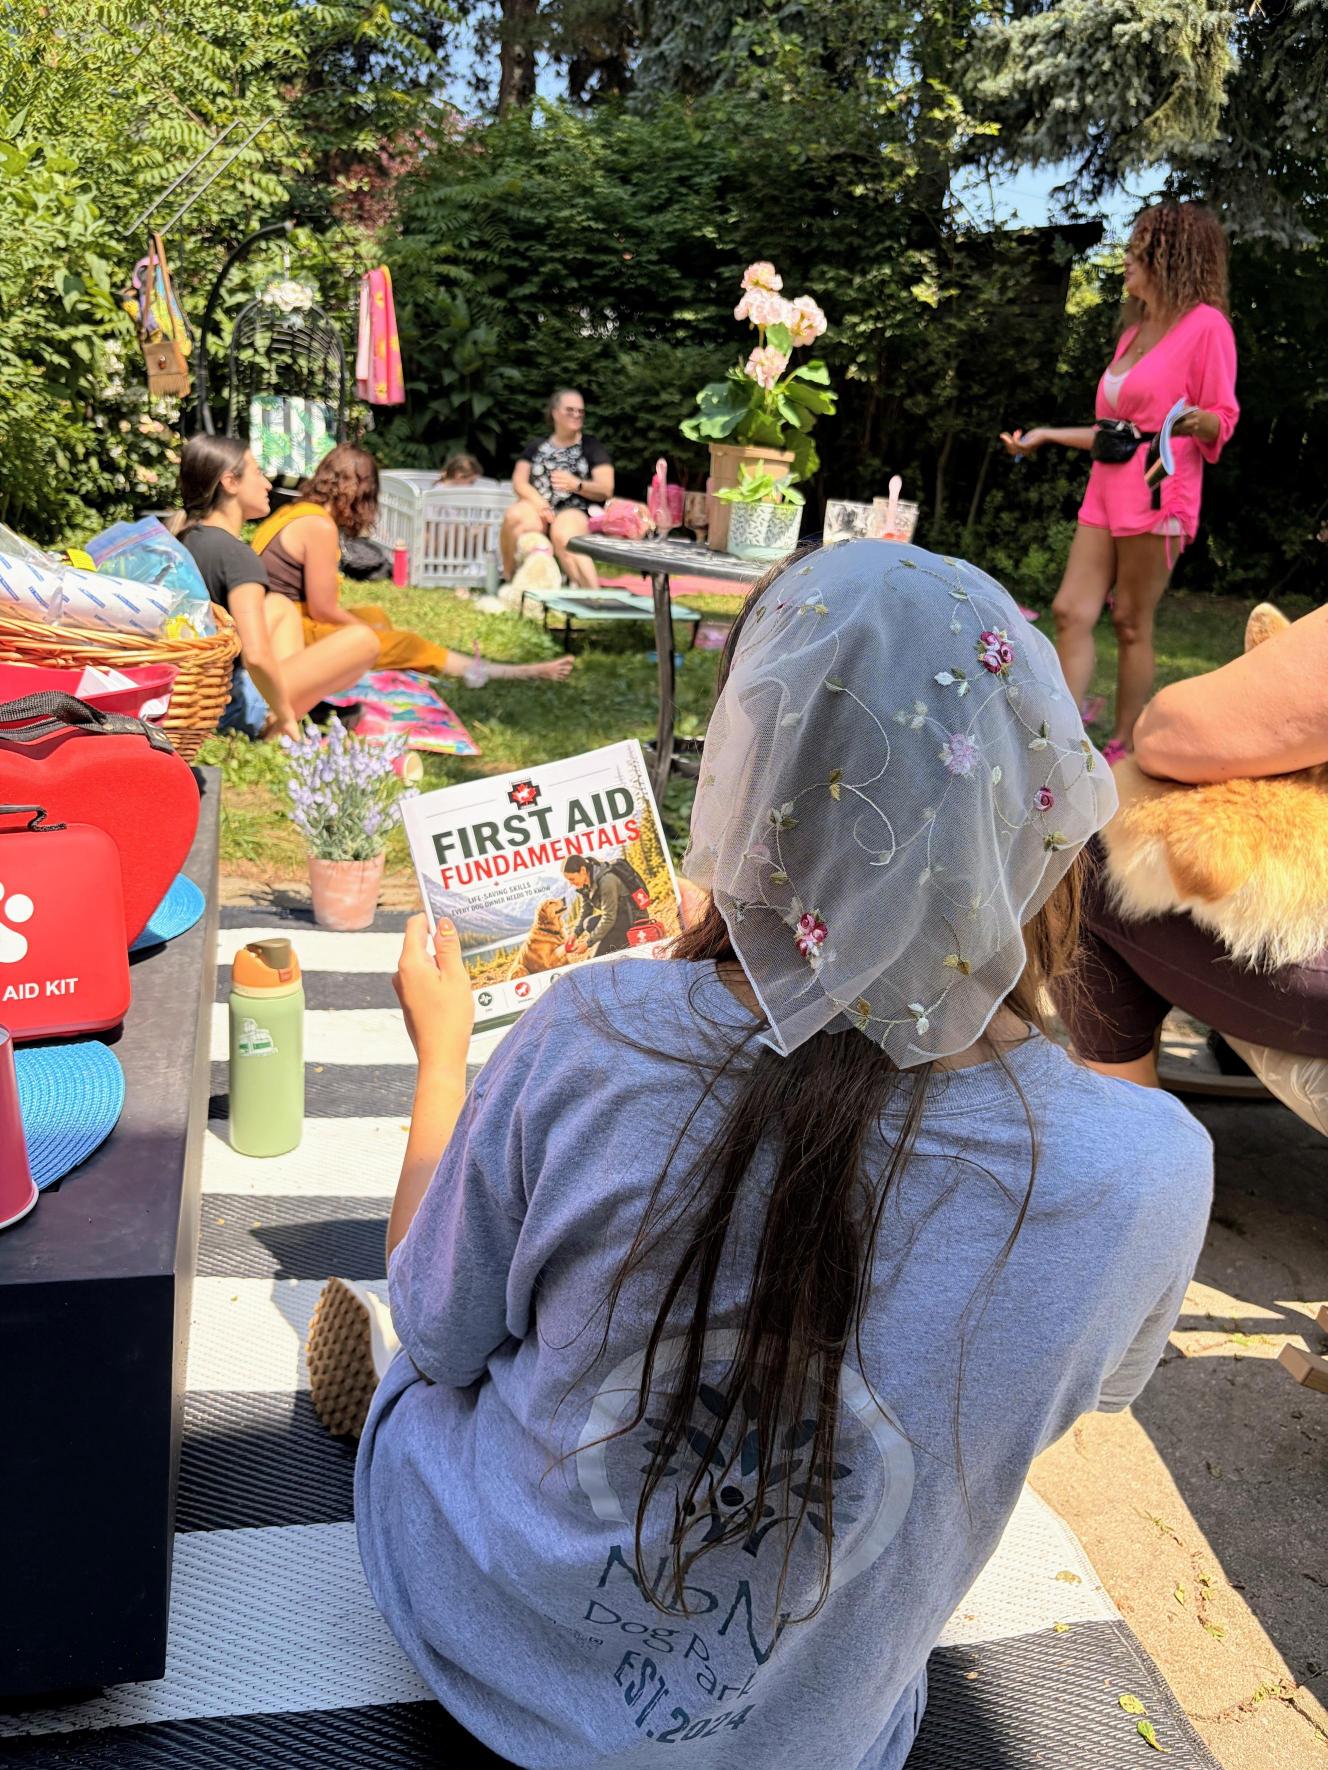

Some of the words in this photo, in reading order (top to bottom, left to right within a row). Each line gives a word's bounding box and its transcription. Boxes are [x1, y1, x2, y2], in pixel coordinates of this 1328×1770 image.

[431, 806, 554, 866] FIRST
[567, 786, 635, 833] AID
[440, 819, 642, 890] FUNDAMENTALS
[467, 888, 508, 904] LIFE-SAVING
[510, 881, 532, 893] SKILLS
[471, 903, 484, 912] DOG
[534, 885, 551, 895] KNOW
[2, 985, 40, 1002] AID
[46, 978, 79, 997] KIT
[583, 1599, 680, 1653] Dog
